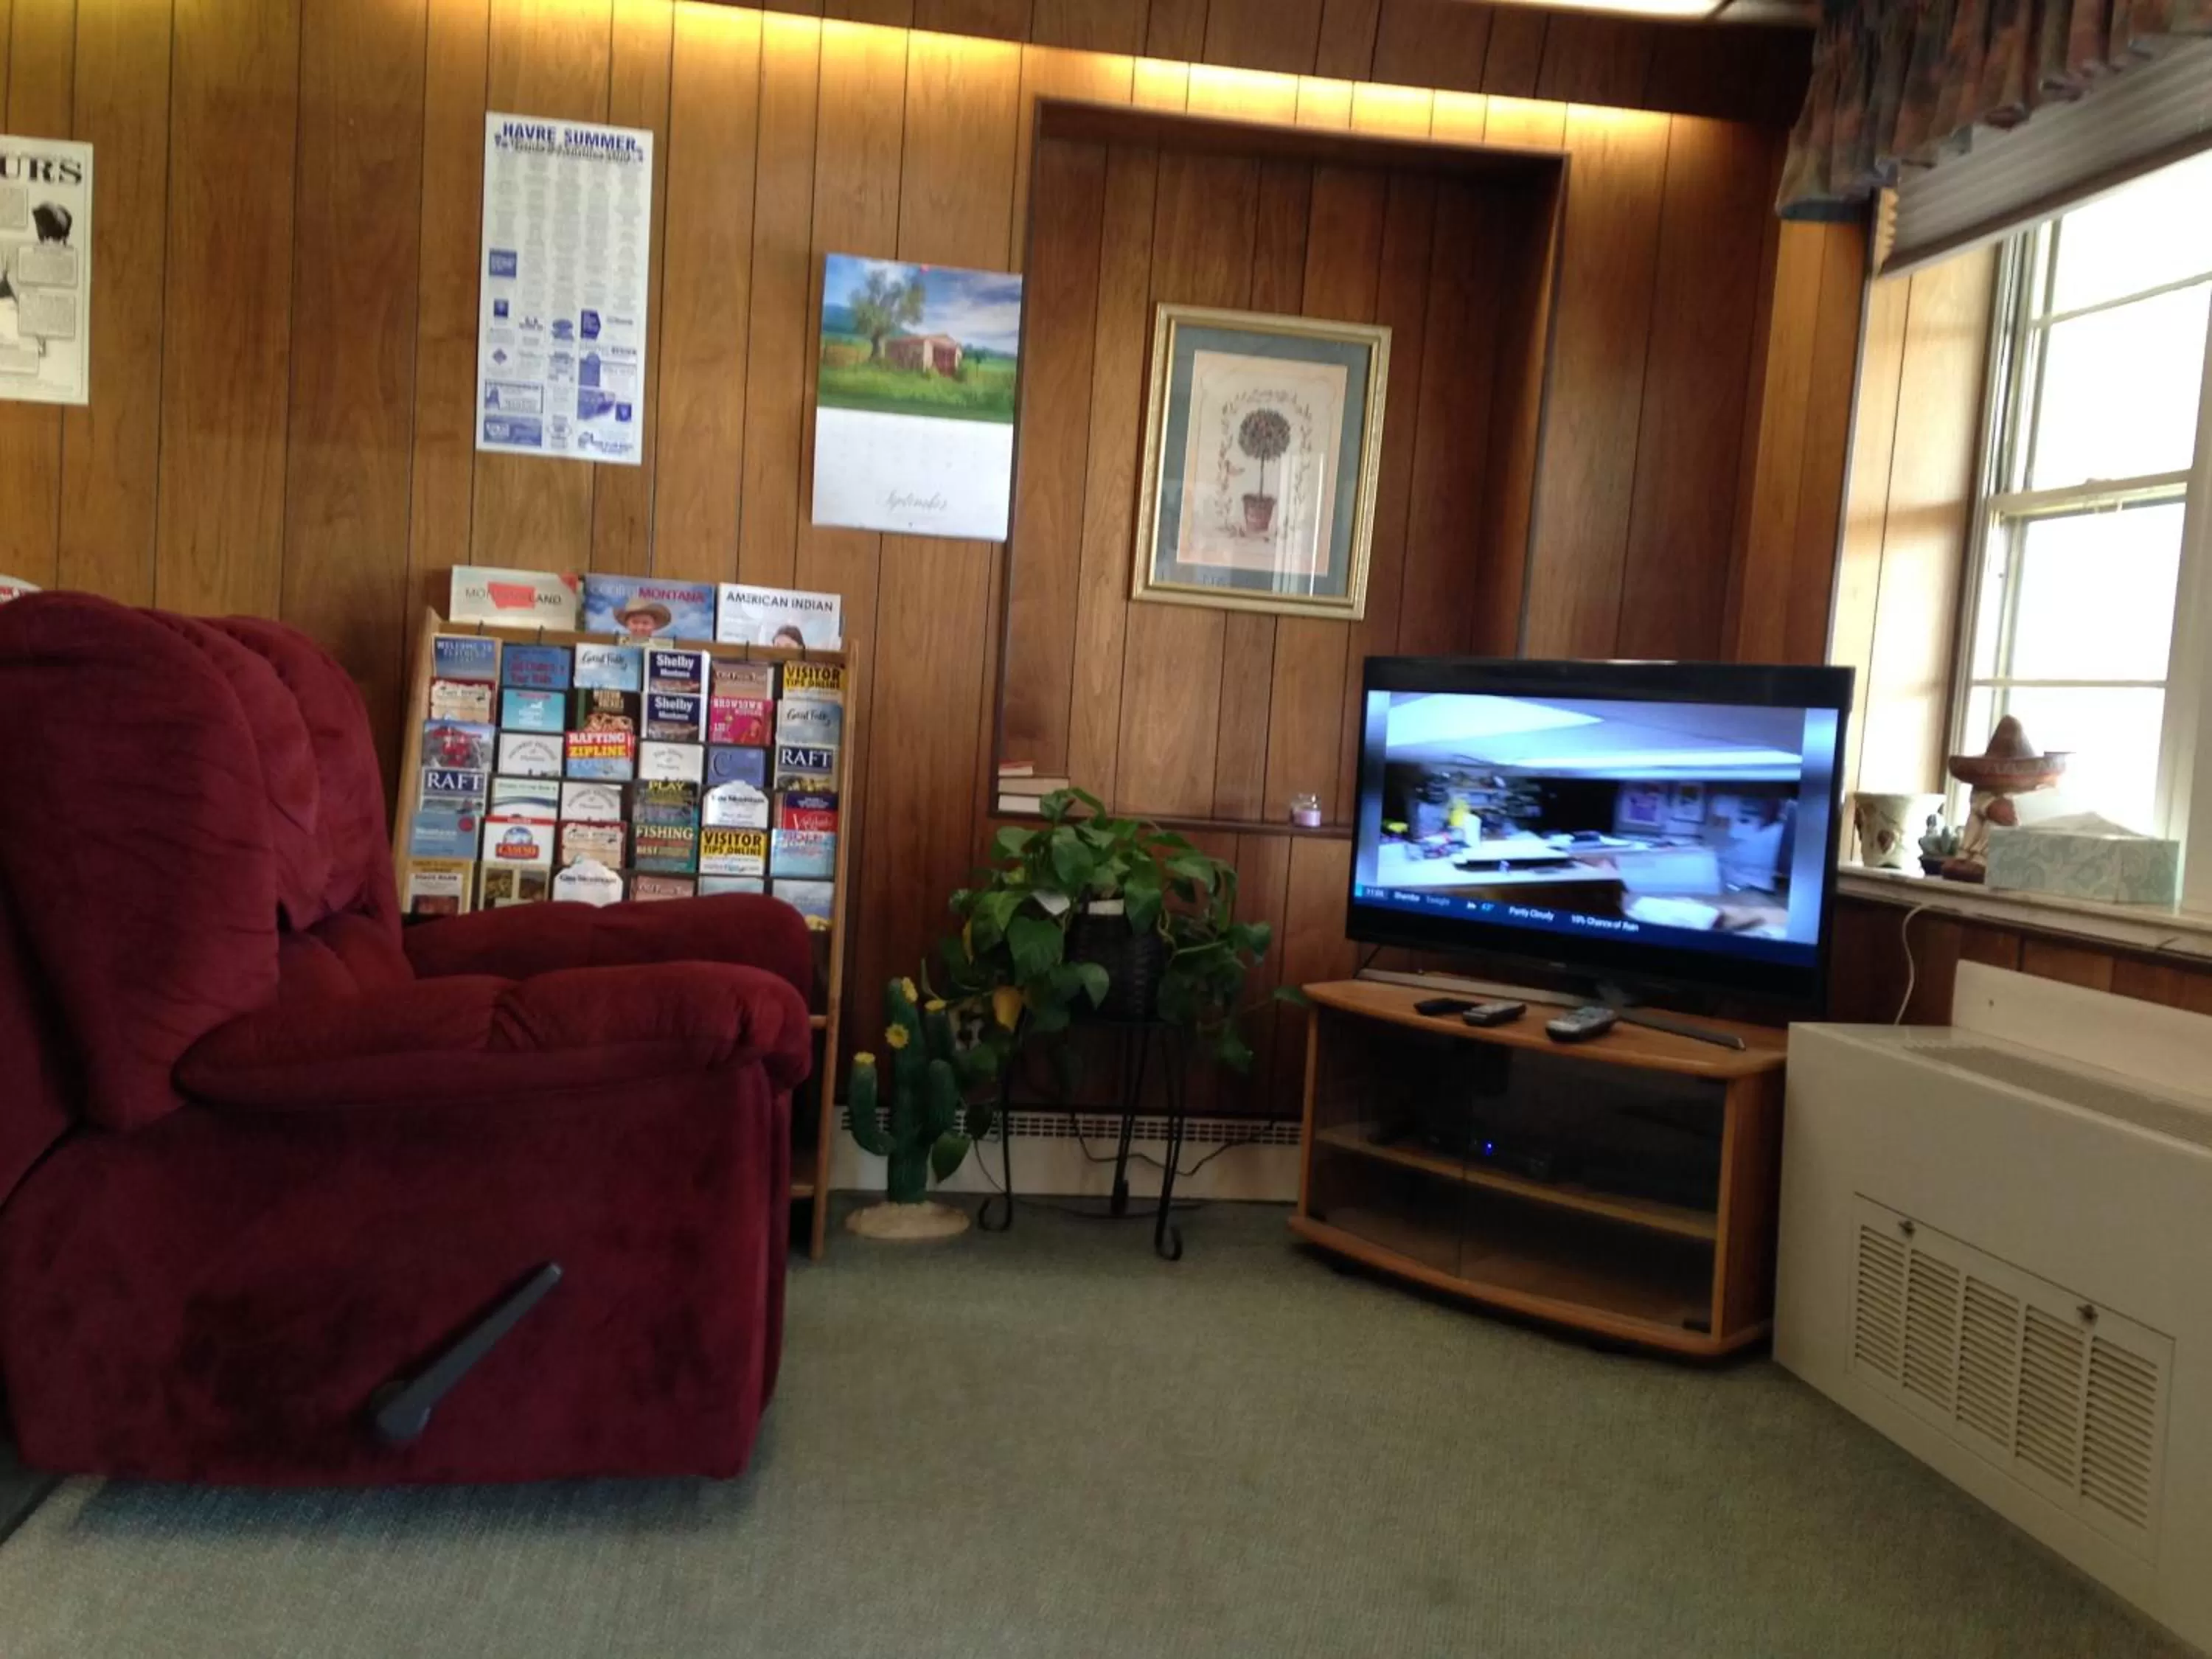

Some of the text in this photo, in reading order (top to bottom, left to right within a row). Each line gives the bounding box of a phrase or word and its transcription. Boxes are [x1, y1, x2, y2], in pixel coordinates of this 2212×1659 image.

[503, 122, 557, 142] HAVRE
[564, 129, 637, 152] SUMMER
[638, 586, 706, 603] MONTANA
[726, 591, 833, 612] AMERICAN INDIAN
[656, 654, 694, 669] Shelby
[785, 666, 840, 680] VISITOR
[655, 696, 693, 712] Shelby
[568, 732, 625, 744] RAFTING
[568, 745, 626, 757] ZIPLINE
[781, 748, 830, 768] RAFT
[427, 772, 480, 791] RAFT
[649, 780, 684, 791] PLAY
[636, 824, 694, 840] FISHING
[704, 831, 762, 846] VISITOR
[703, 845, 761, 855] TIPS ONLINE
[1530, 909, 1554, 921] Cloudy
